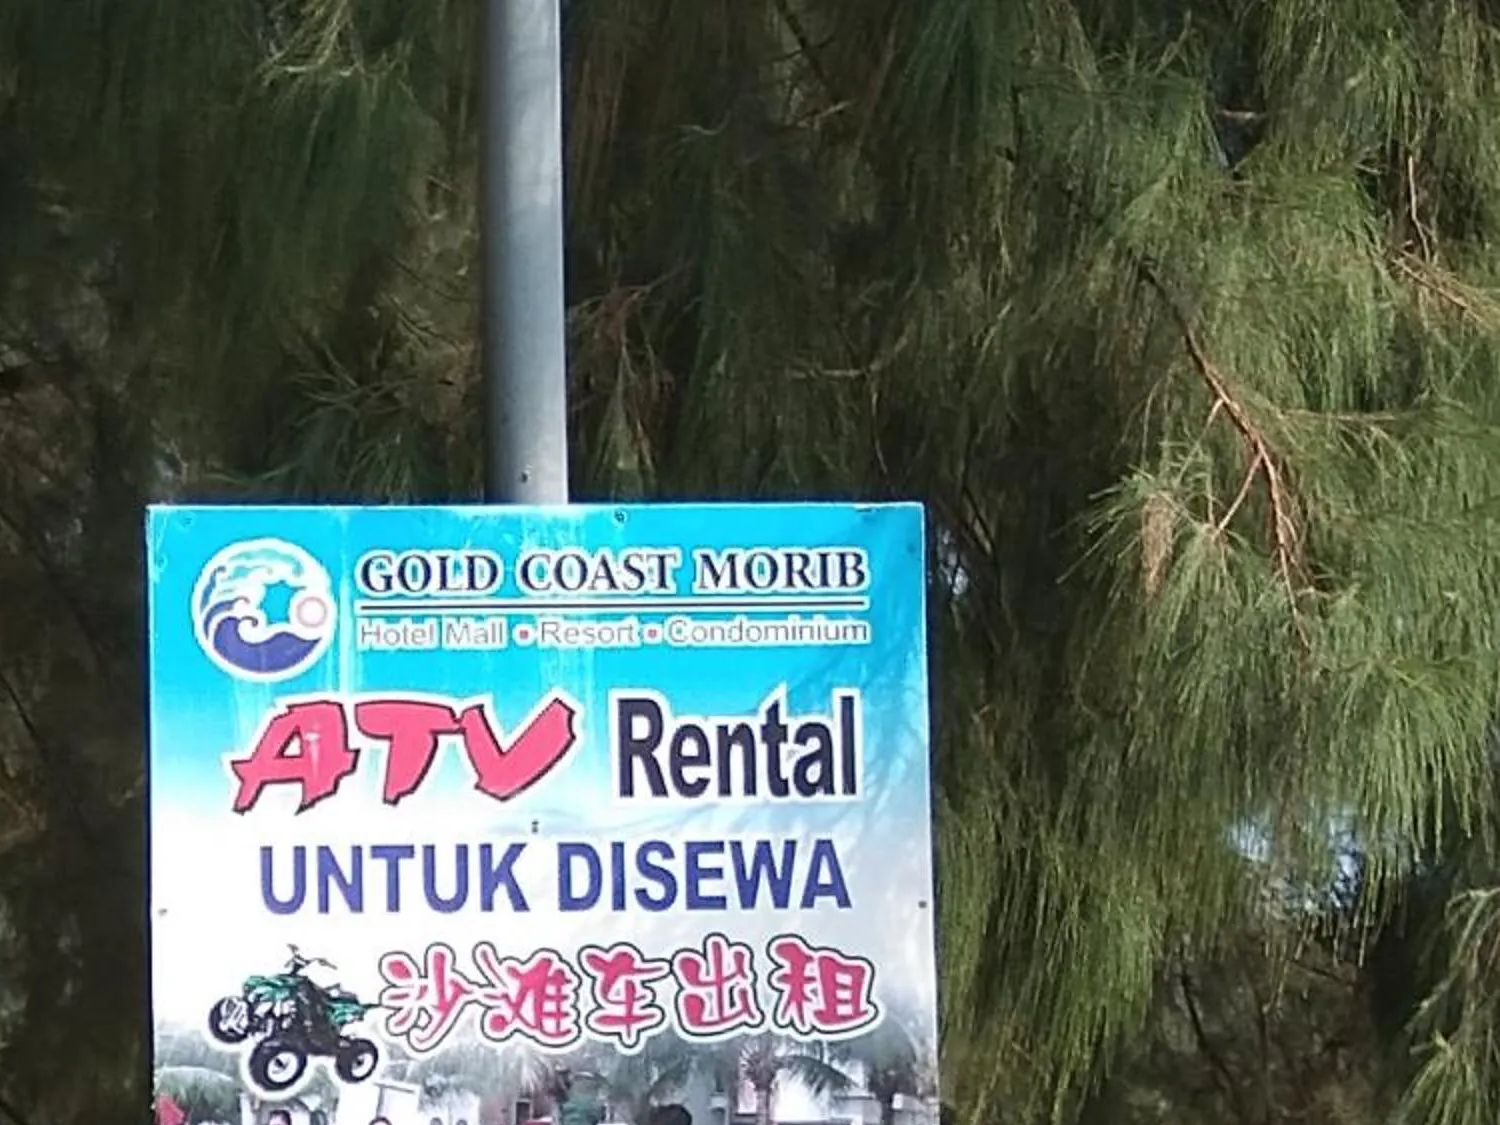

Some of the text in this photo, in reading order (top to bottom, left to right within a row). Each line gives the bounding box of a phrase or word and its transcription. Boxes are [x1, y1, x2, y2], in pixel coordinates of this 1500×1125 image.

[360, 550, 866, 593] GOLD COAST MORIB
[360, 618, 868, 646] Hotel Mall Resort Condominium
[231, 695, 858, 815] ATV Rental
[259, 839, 853, 914] UNTUK DISEWA
[379, 933, 876, 1052] 沙滩车出租
